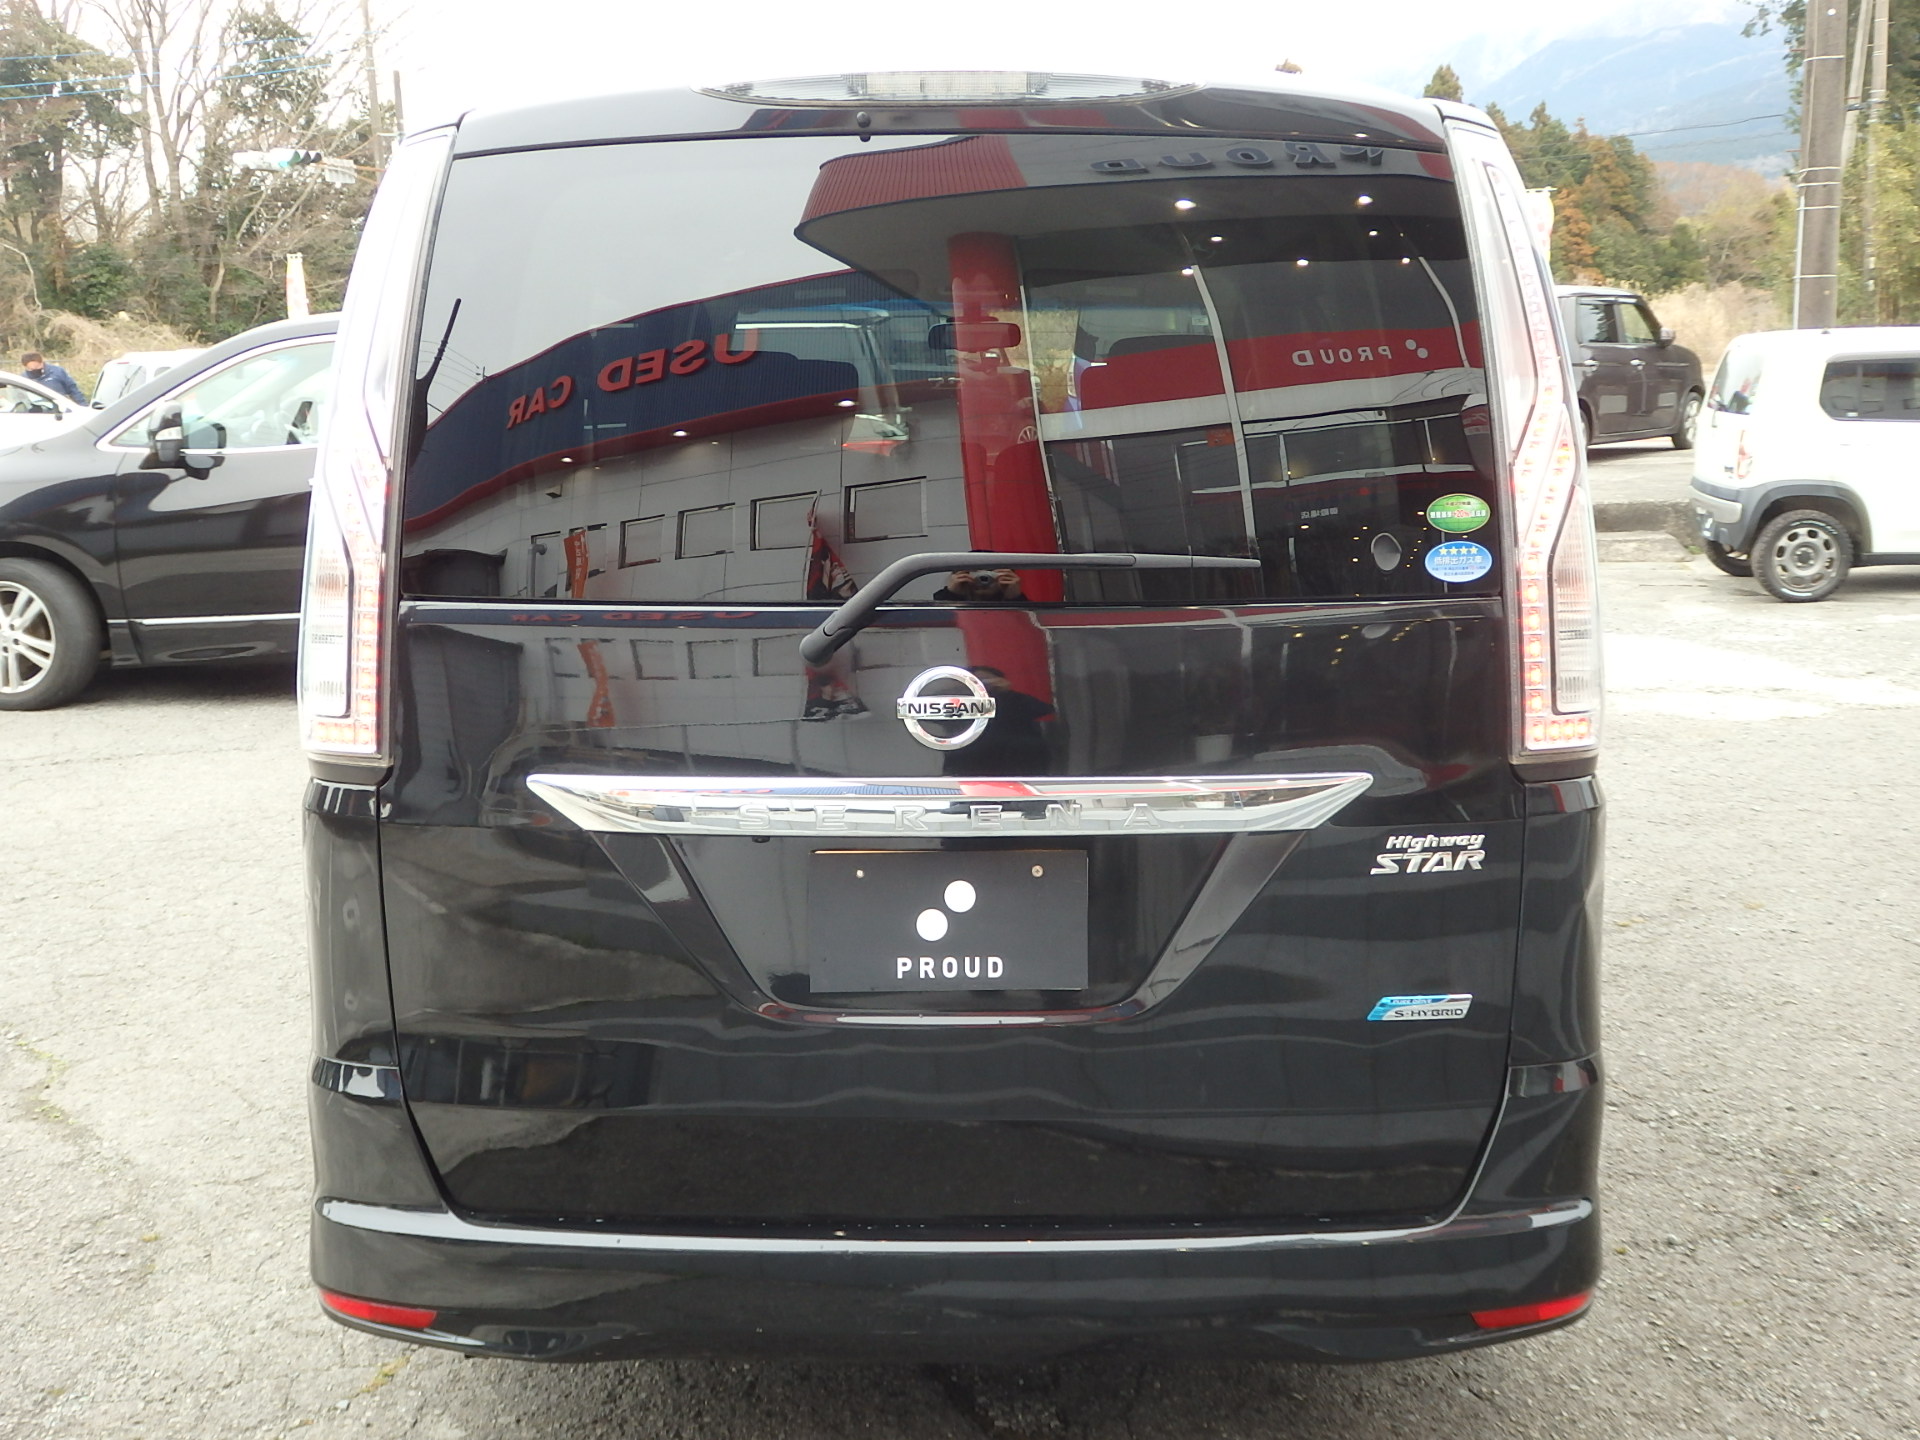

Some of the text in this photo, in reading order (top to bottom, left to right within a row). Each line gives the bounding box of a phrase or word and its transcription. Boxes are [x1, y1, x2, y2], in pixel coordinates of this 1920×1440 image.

[907, 702, 984, 715] NISSAN
[738, 803, 1160, 831] SERENA
[1386, 834, 1485, 852] Highway
[1370, 849, 1486, 875] STAR
[896, 956, 1004, 979] PROUD
[1394, 1008, 1464, 1018] S-HYBRID
